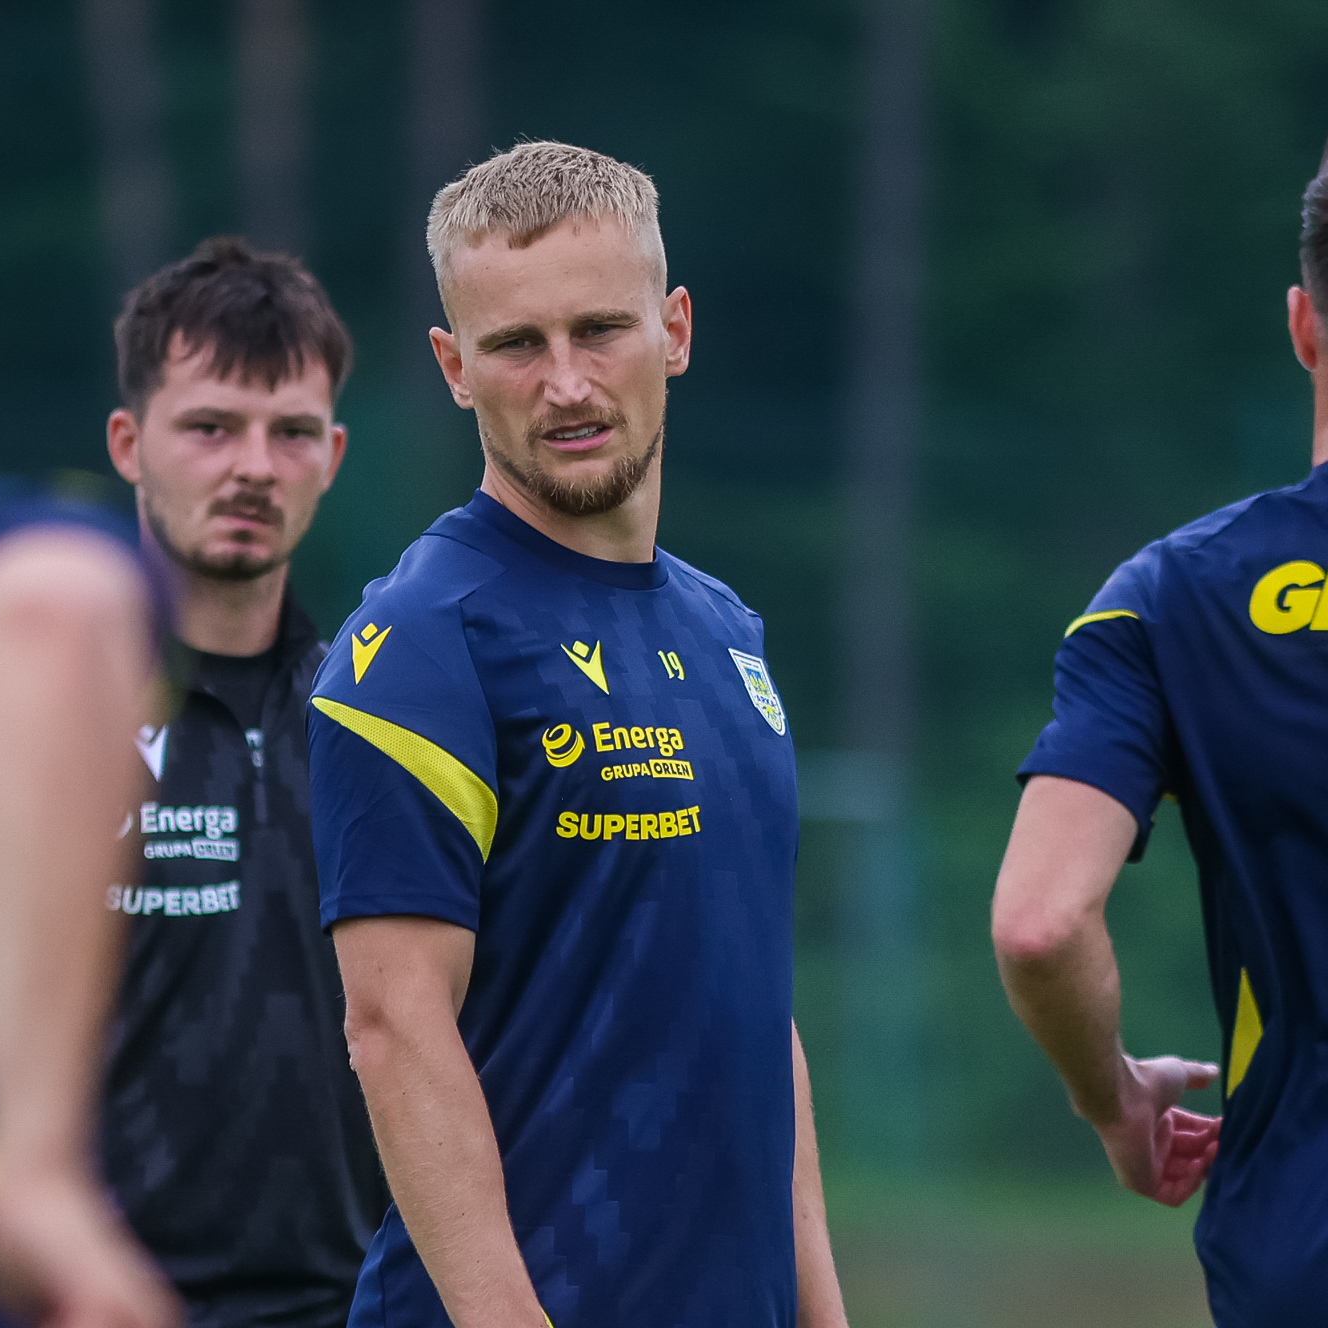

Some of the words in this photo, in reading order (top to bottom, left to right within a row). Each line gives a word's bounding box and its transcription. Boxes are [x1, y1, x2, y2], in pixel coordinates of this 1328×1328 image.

[657, 650, 685, 681] 19
[592, 722, 684, 757] Energa
[601, 763, 651, 781] GRUPA
[652, 761, 691, 778] ORLEN
[140, 802, 239, 840] Energa
[556, 805, 701, 841] SUPERBET
[144, 840, 192, 859] GRUPA
[107, 880, 241, 916] SUPERBET
